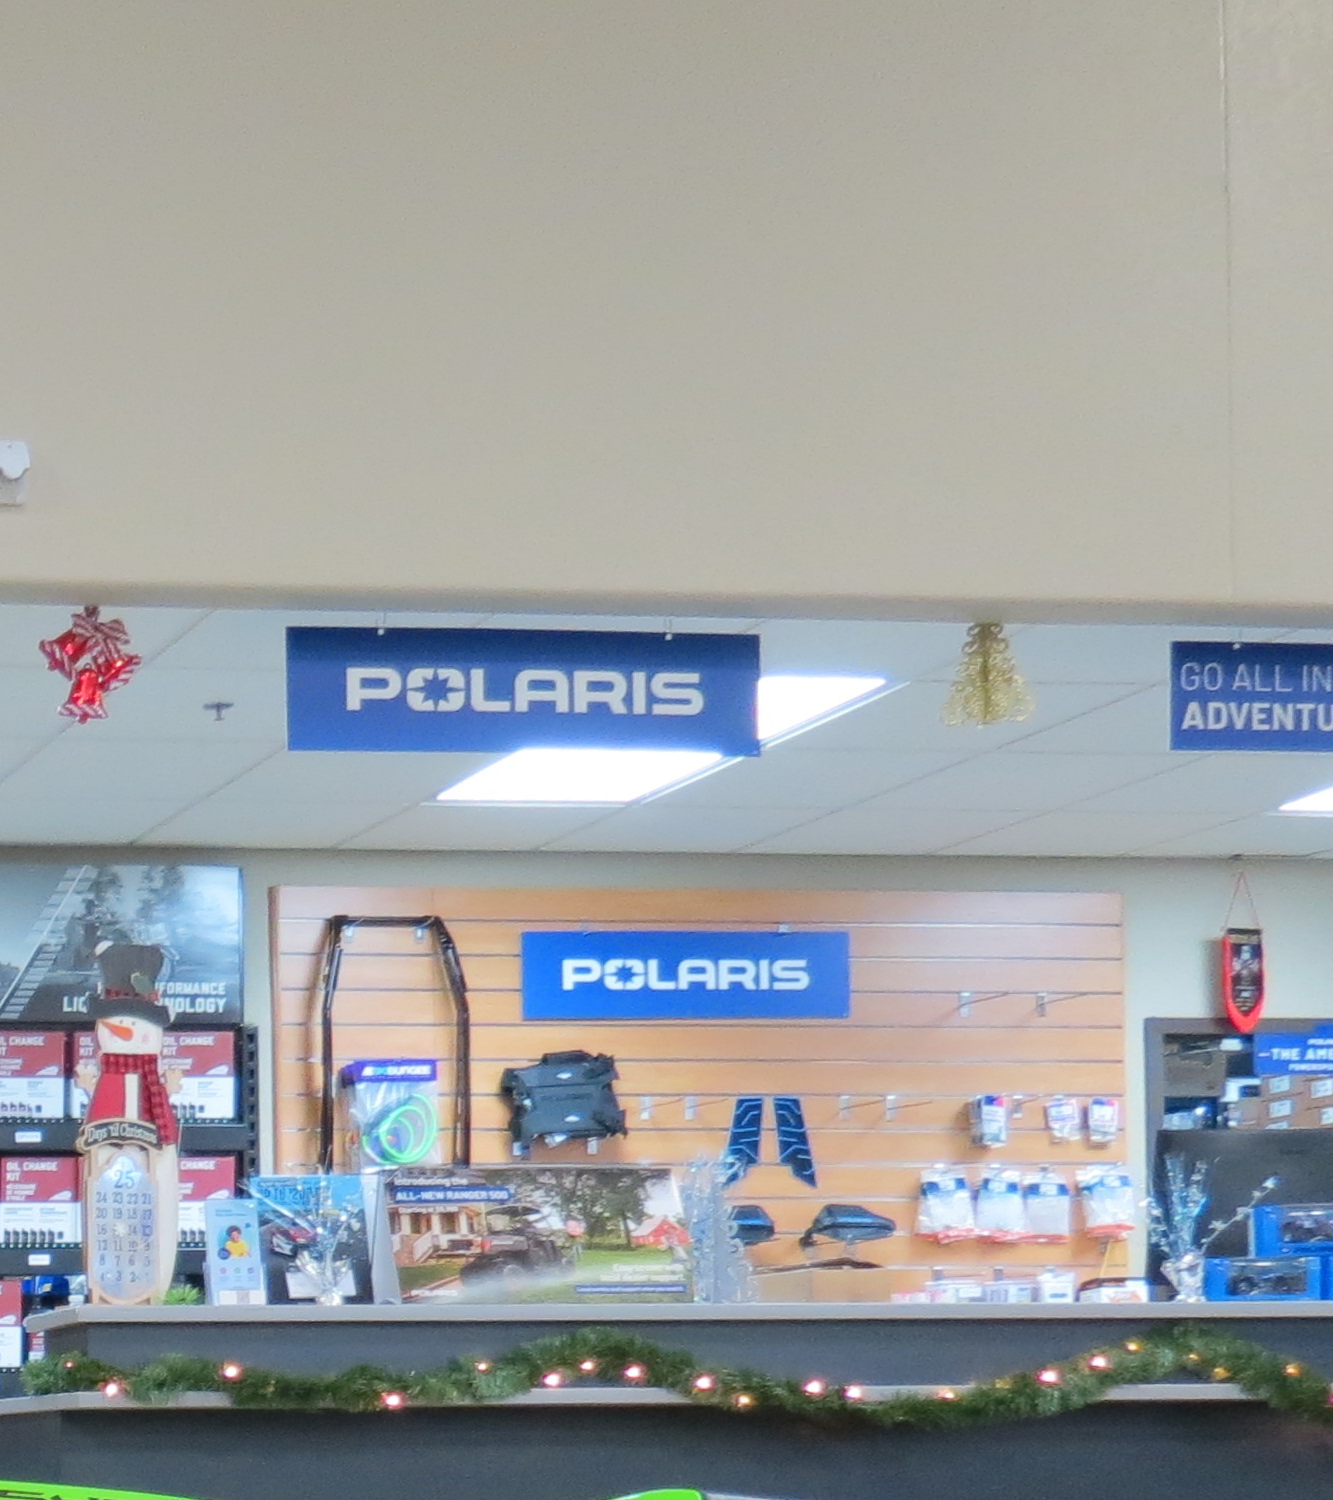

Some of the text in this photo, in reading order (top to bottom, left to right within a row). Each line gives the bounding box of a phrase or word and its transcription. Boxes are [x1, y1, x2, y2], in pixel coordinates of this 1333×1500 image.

[1180, 662, 1223, 691] GO
[1232, 664, 1293, 692] ALL
[344, 666, 706, 717] POLARIS
[560, 957, 811, 991] POLARIS
[9, 1036, 44, 1046] CHANGE
[179, 1036, 215, 1046] CHANGE
[23, 1161, 58, 1171] CHANGE
[180, 1160, 216, 1170] CHANGE
[114, 1169, 134, 1189] 25
[396, 1190, 445, 1201] ALL-NEW
[446, 1190, 487, 1200] RANGER
[96, 1208, 107, 1219] 20
